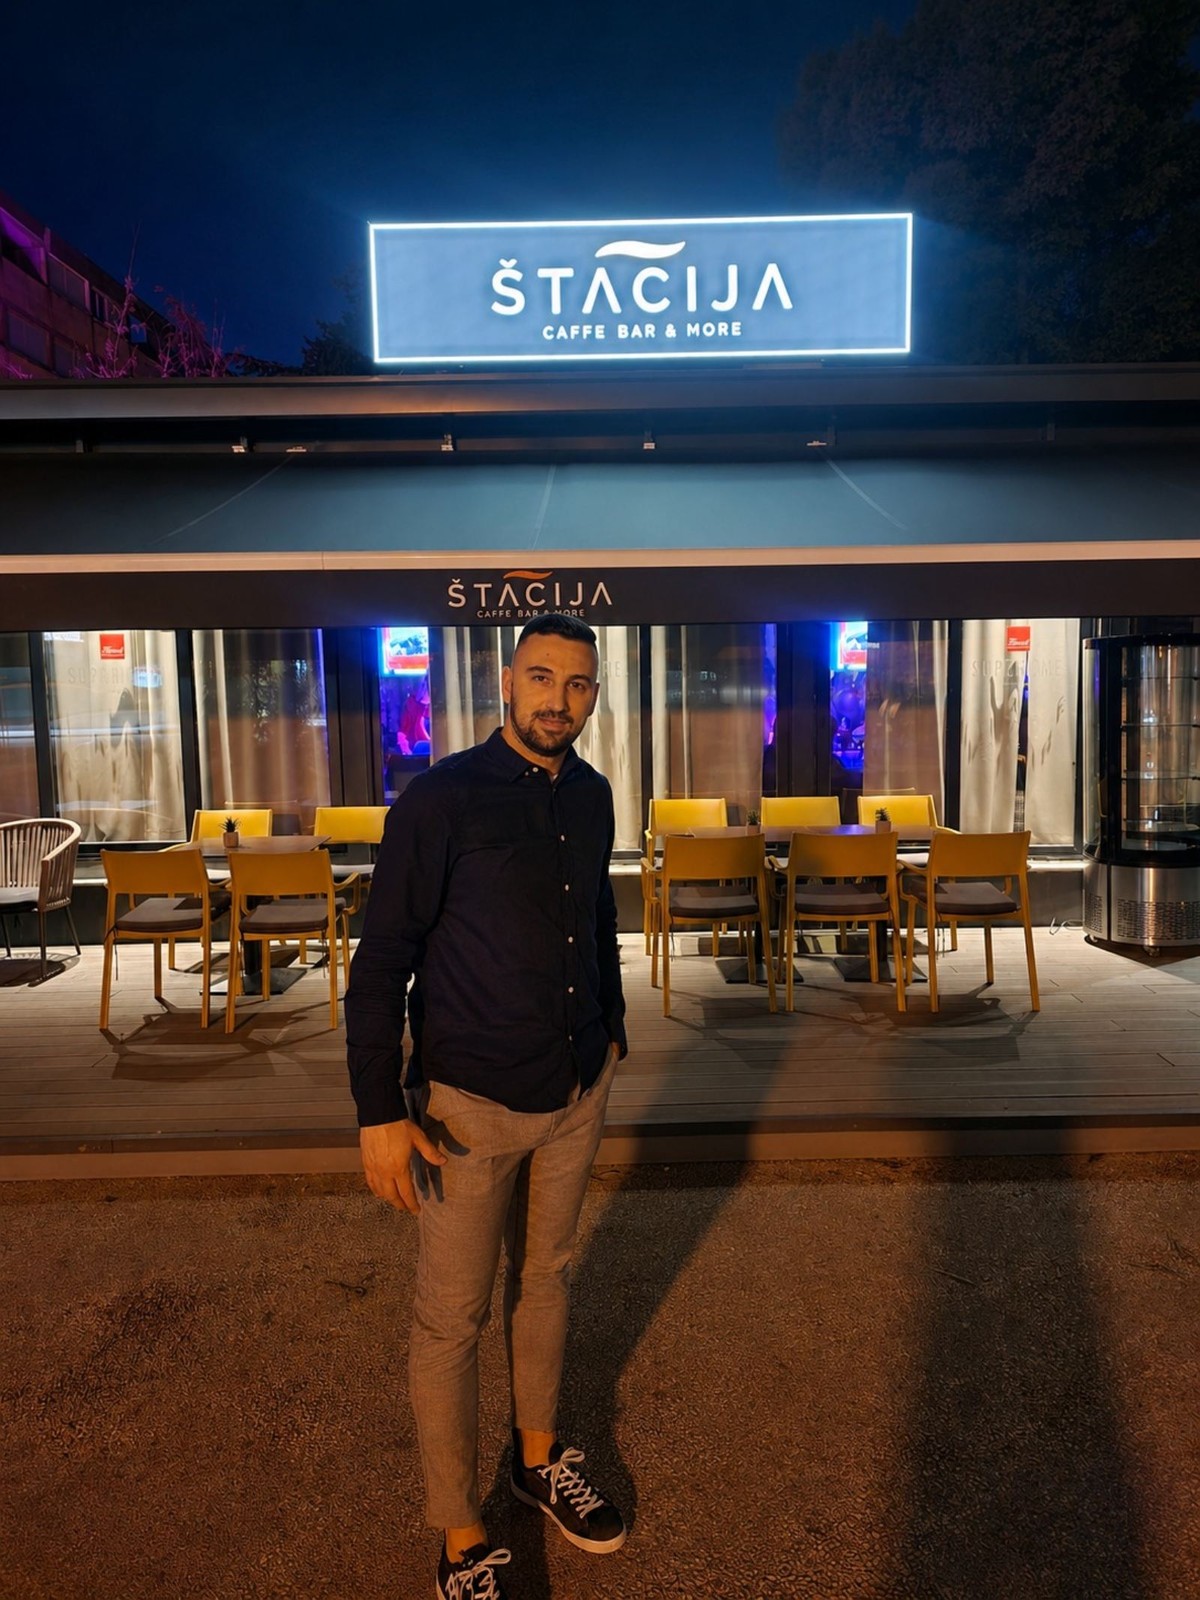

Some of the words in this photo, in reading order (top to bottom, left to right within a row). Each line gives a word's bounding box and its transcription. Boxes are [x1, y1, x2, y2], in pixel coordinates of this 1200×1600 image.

[491, 258, 793, 315] ŠTACIJA
[541, 325, 606, 340] CAFFE
[617, 324, 655, 338] BAR
[665, 323, 677, 338] &
[687, 322, 742, 337] MORE
[448, 578, 613, 607] ŠTACIJA
[476, 610, 511, 618] CAFFE
